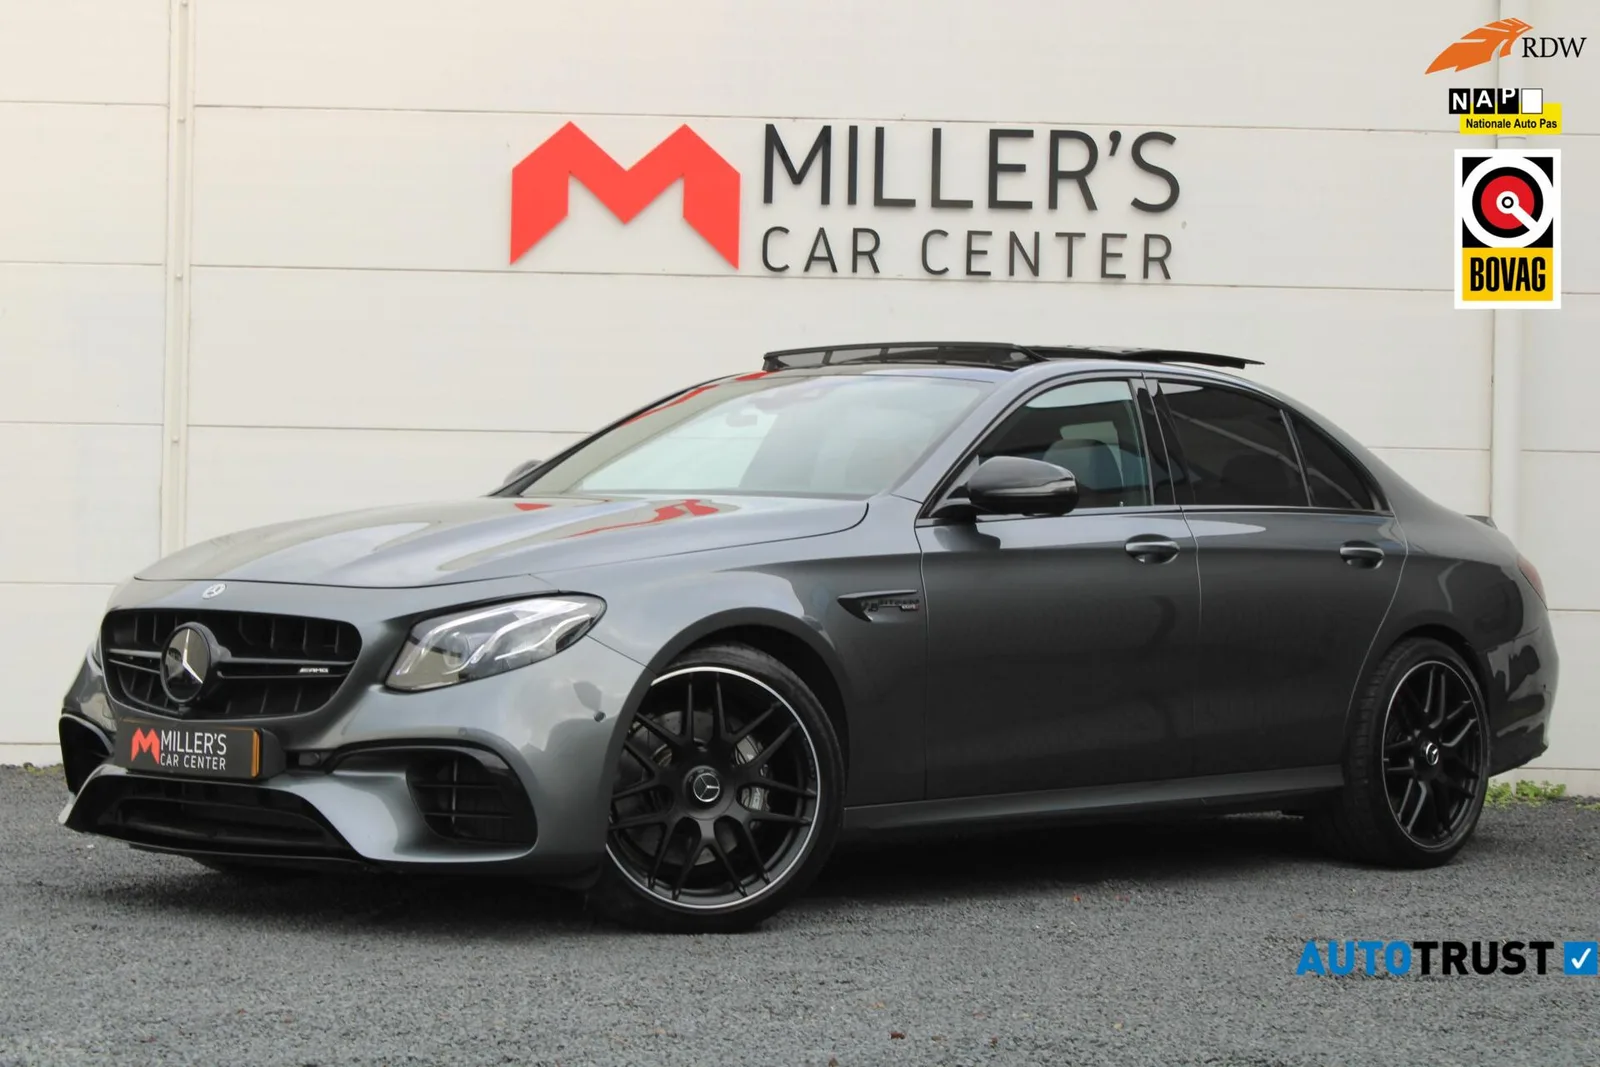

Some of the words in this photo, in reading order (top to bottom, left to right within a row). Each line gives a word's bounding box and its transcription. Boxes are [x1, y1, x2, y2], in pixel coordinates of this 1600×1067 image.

[763, 123, 1180, 213] MILLER'S
[762, 226, 881, 275] CAR
[921, 229, 1173, 280] CENTER
[160, 753, 179, 767] CAR
[183, 755, 226, 770] CENTER
[161, 729, 227, 755] MILLER'S
